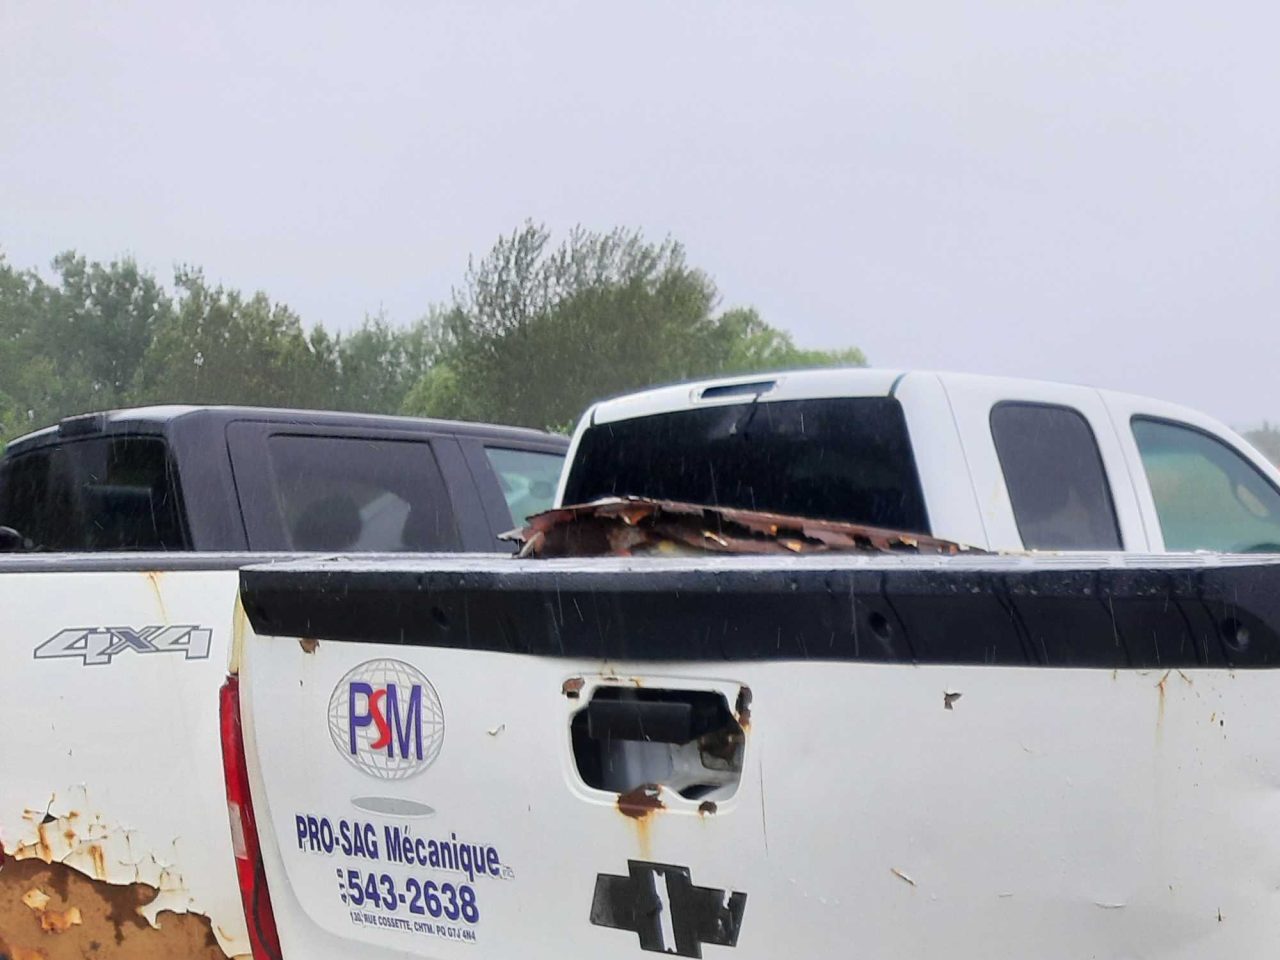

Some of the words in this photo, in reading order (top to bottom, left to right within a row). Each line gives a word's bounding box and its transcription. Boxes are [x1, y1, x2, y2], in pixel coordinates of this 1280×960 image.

[349, 681, 423, 760] PSM
[295, 814, 379, 860] PRO-SAG
[384, 825, 500, 882] Mécanique
[347, 869, 479, 924] 543-2638
